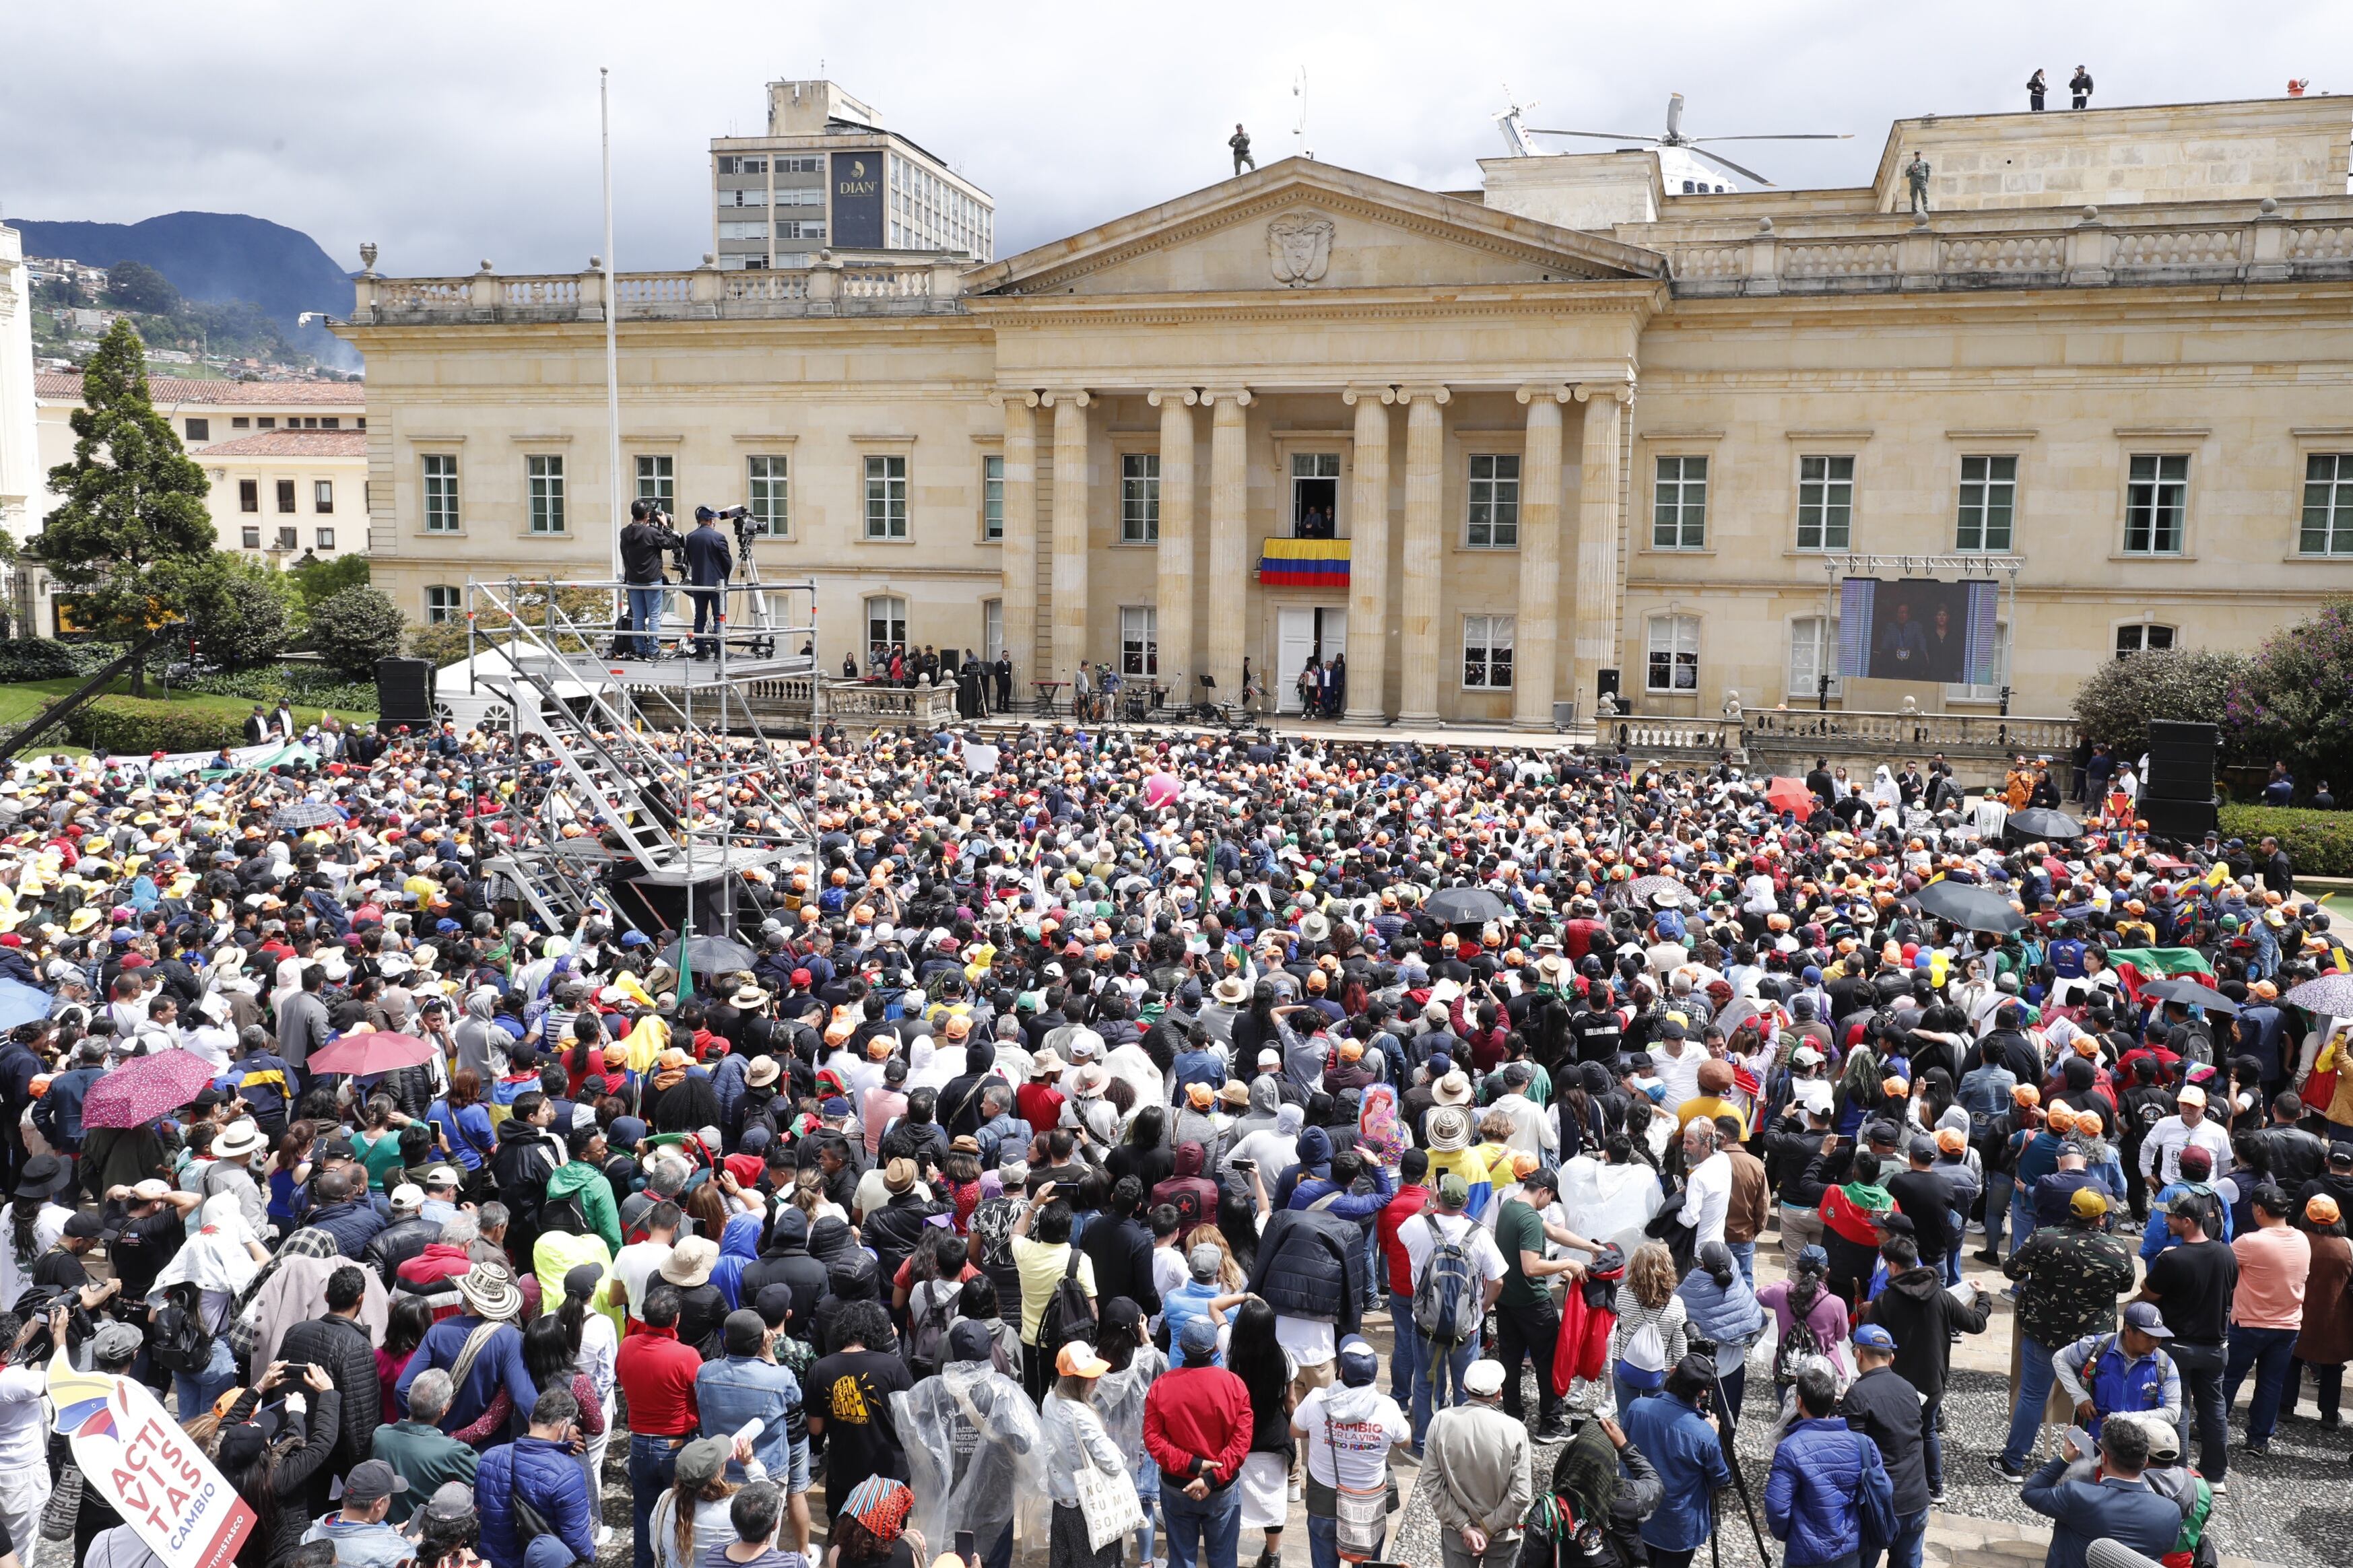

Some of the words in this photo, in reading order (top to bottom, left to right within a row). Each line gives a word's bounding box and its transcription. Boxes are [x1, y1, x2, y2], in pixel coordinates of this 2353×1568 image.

[840, 182, 874, 194] DIAN
[1586, 1027, 1604, 1036] ROLLING
[1604, 1026, 1619, 1034] STONES
[1782, 1367, 1797, 1377] adi
[1325, 1419, 1383, 1433] CAMBIO
[1325, 1429, 1344, 1439] POR
[111, 1417, 166, 1499] ACTI
[125, 1439, 183, 1512] VIS
[145, 1460, 201, 1534] TAS
[1086, 1482, 1103, 1497] NO
[1089, 1499, 1106, 1513] TU
[170, 1482, 215, 1550] CAMBIO
[1094, 1513, 1118, 1530] SOY
[1098, 1516, 1145, 1547] POEMAS
